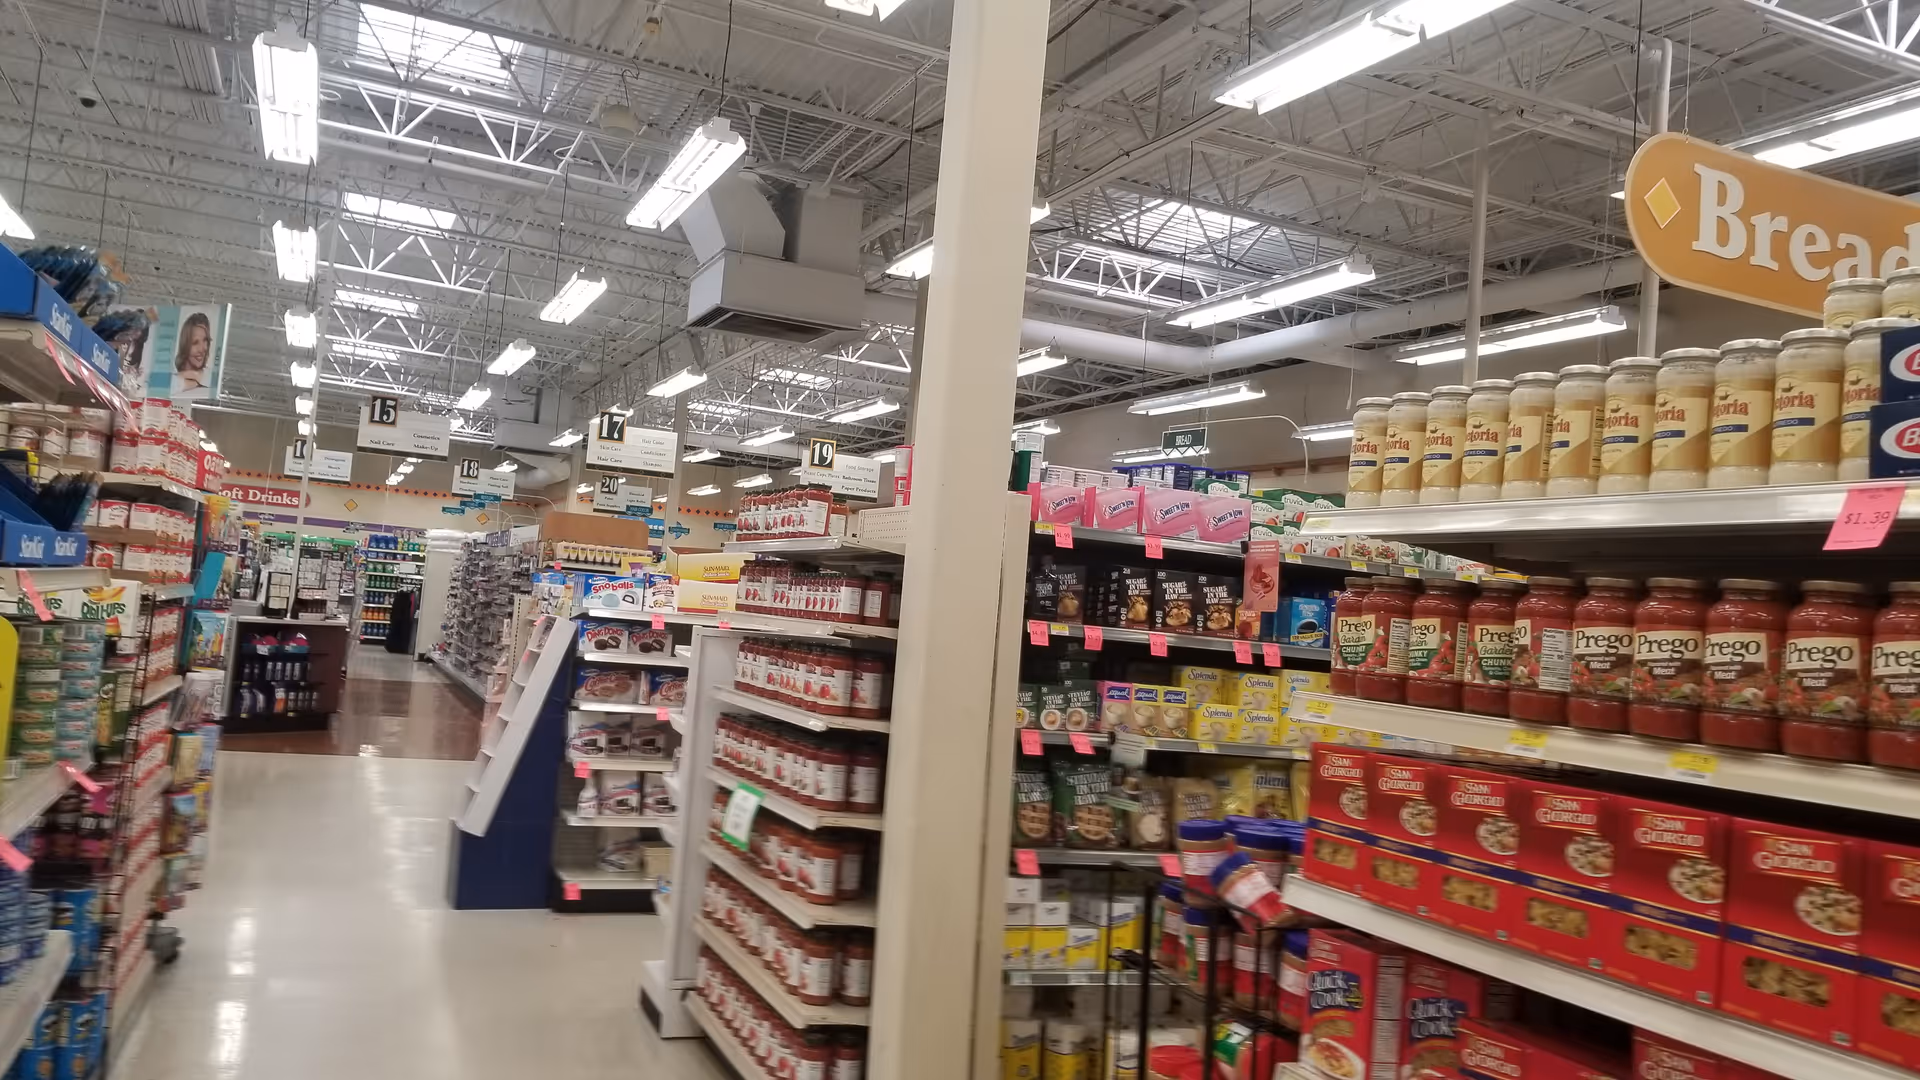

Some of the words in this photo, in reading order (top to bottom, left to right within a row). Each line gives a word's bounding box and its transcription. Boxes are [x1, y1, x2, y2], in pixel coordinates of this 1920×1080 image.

[372, 399, 396, 423] 15
[600, 414, 625, 439] 17
[413, 433, 440, 441] Cosmetics
[1175, 434, 1192, 446] BREAD
[812, 442, 833, 466] 19
[462, 460, 478, 478] 18
[642, 460, 662, 468] Shampoo
[602, 476, 618, 492] 20
[856, 486, 876, 494] Products
[1210, 484, 1229, 494] truvia
[248, 488, 299, 506] Drinks
[1284, 496, 1304, 506] truvia
[1252, 504, 1272, 513] truvia
[1844, 511, 1890, 524] $1.39
[1252, 528, 1272, 537] truvia
[1410, 624, 1436, 639] rego
[1575, 630, 1634, 654] Prego
[1637, 634, 1699, 660] Prego
[1788, 642, 1854, 668] Prego
[1188, 668, 1218, 680] Splenda
[1287, 674, 1310, 684] Splenda
[1714, 671, 1736, 679] Meat
[1245, 676, 1274, 688] Splenda
[1802, 678, 1828, 686] Meat
[1889, 684, 1917, 693] Meat
[1202, 707, 1233, 718] Splenda
[1244, 710, 1274, 722] Splenda
